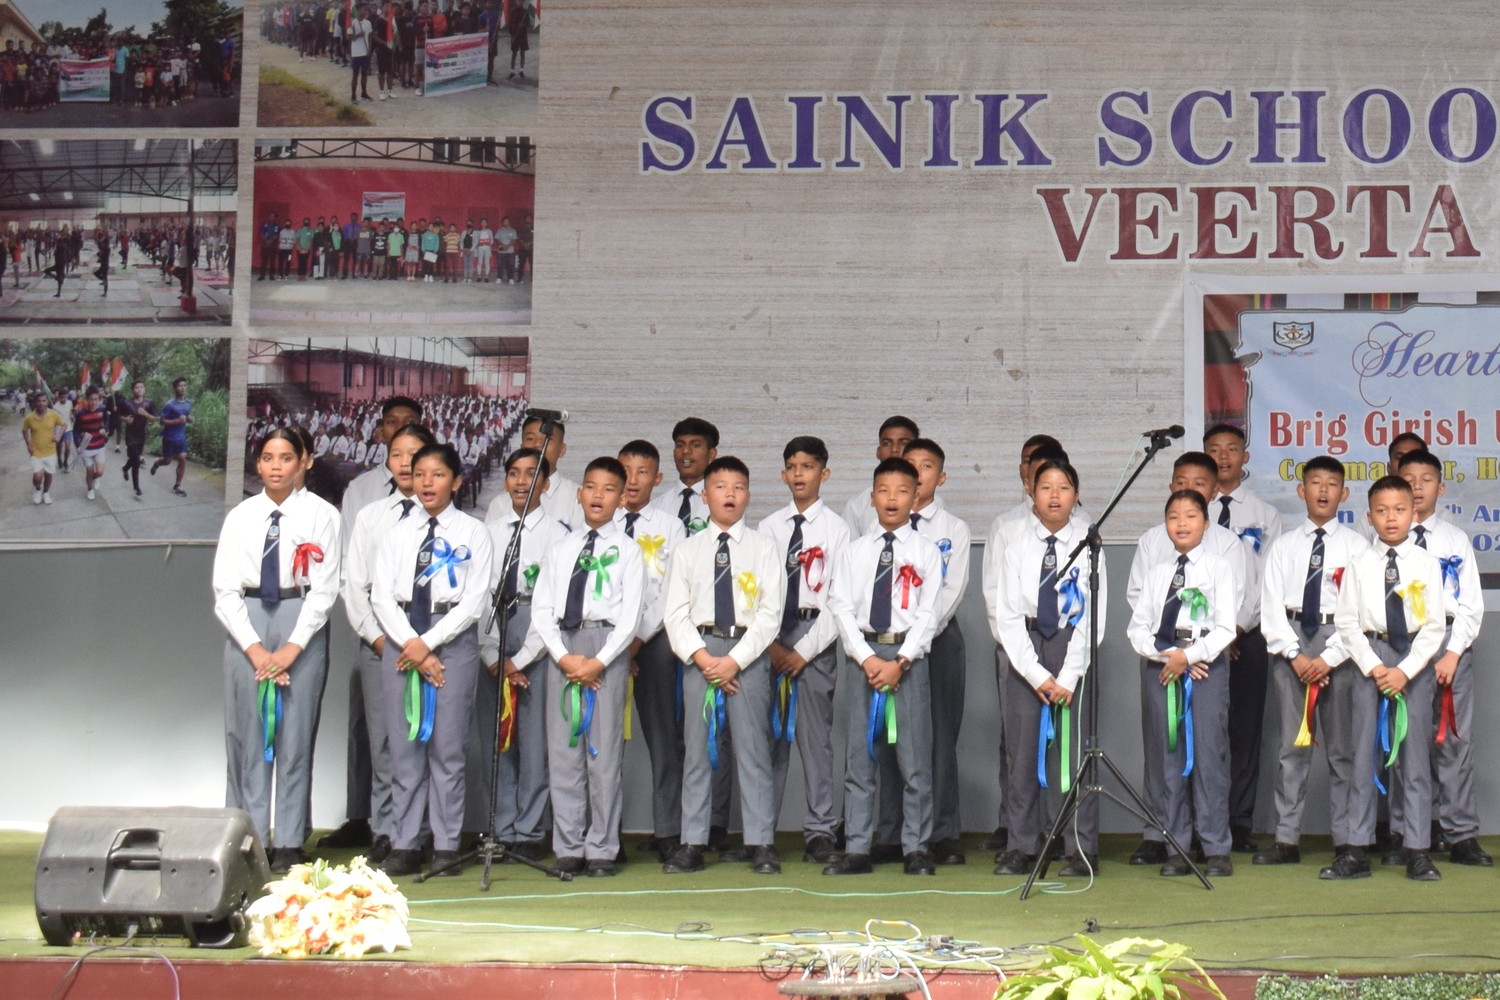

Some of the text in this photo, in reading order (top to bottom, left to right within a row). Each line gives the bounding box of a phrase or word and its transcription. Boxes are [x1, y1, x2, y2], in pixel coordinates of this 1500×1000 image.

[640, 92, 1052, 172] SAINIK
[1037, 182, 1484, 264] VEERTA
[1269, 410, 1348, 455] Brig
[1364, 409, 1477, 447] Girish
